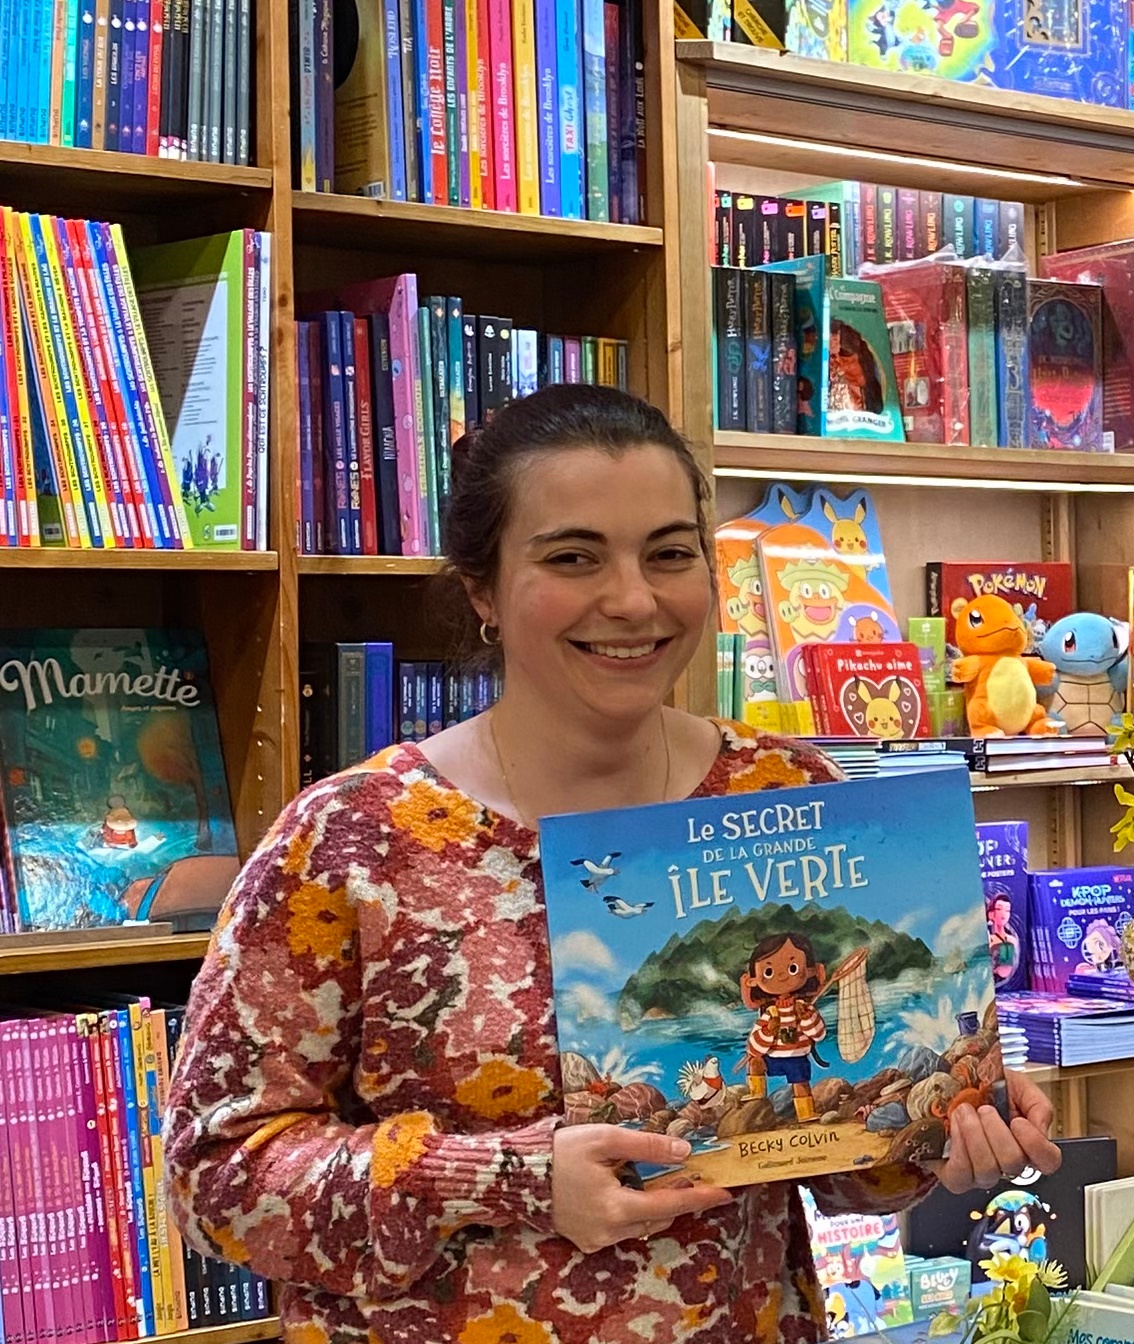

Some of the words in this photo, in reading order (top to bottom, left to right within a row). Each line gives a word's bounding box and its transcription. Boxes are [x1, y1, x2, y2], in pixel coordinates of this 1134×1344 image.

[498, 62, 509, 105] Brooklyn
[837, 658, 886, 672] Pikachu
[889, 659, 913, 672] aime
[0, 658, 200, 715] Mamette
[687, 817, 714, 843] Le
[721, 800, 825, 840] SECRET
[702, 848, 726, 864] DE
[730, 845, 749, 860] LA
[752, 837, 817, 857] GRANDE
[668, 865, 734, 920] ÎLE
[743, 844, 869, 903] VERTE
[738, 1138, 786, 1158] BECKY
[817, 1222, 883, 1244] HISTOIRE
